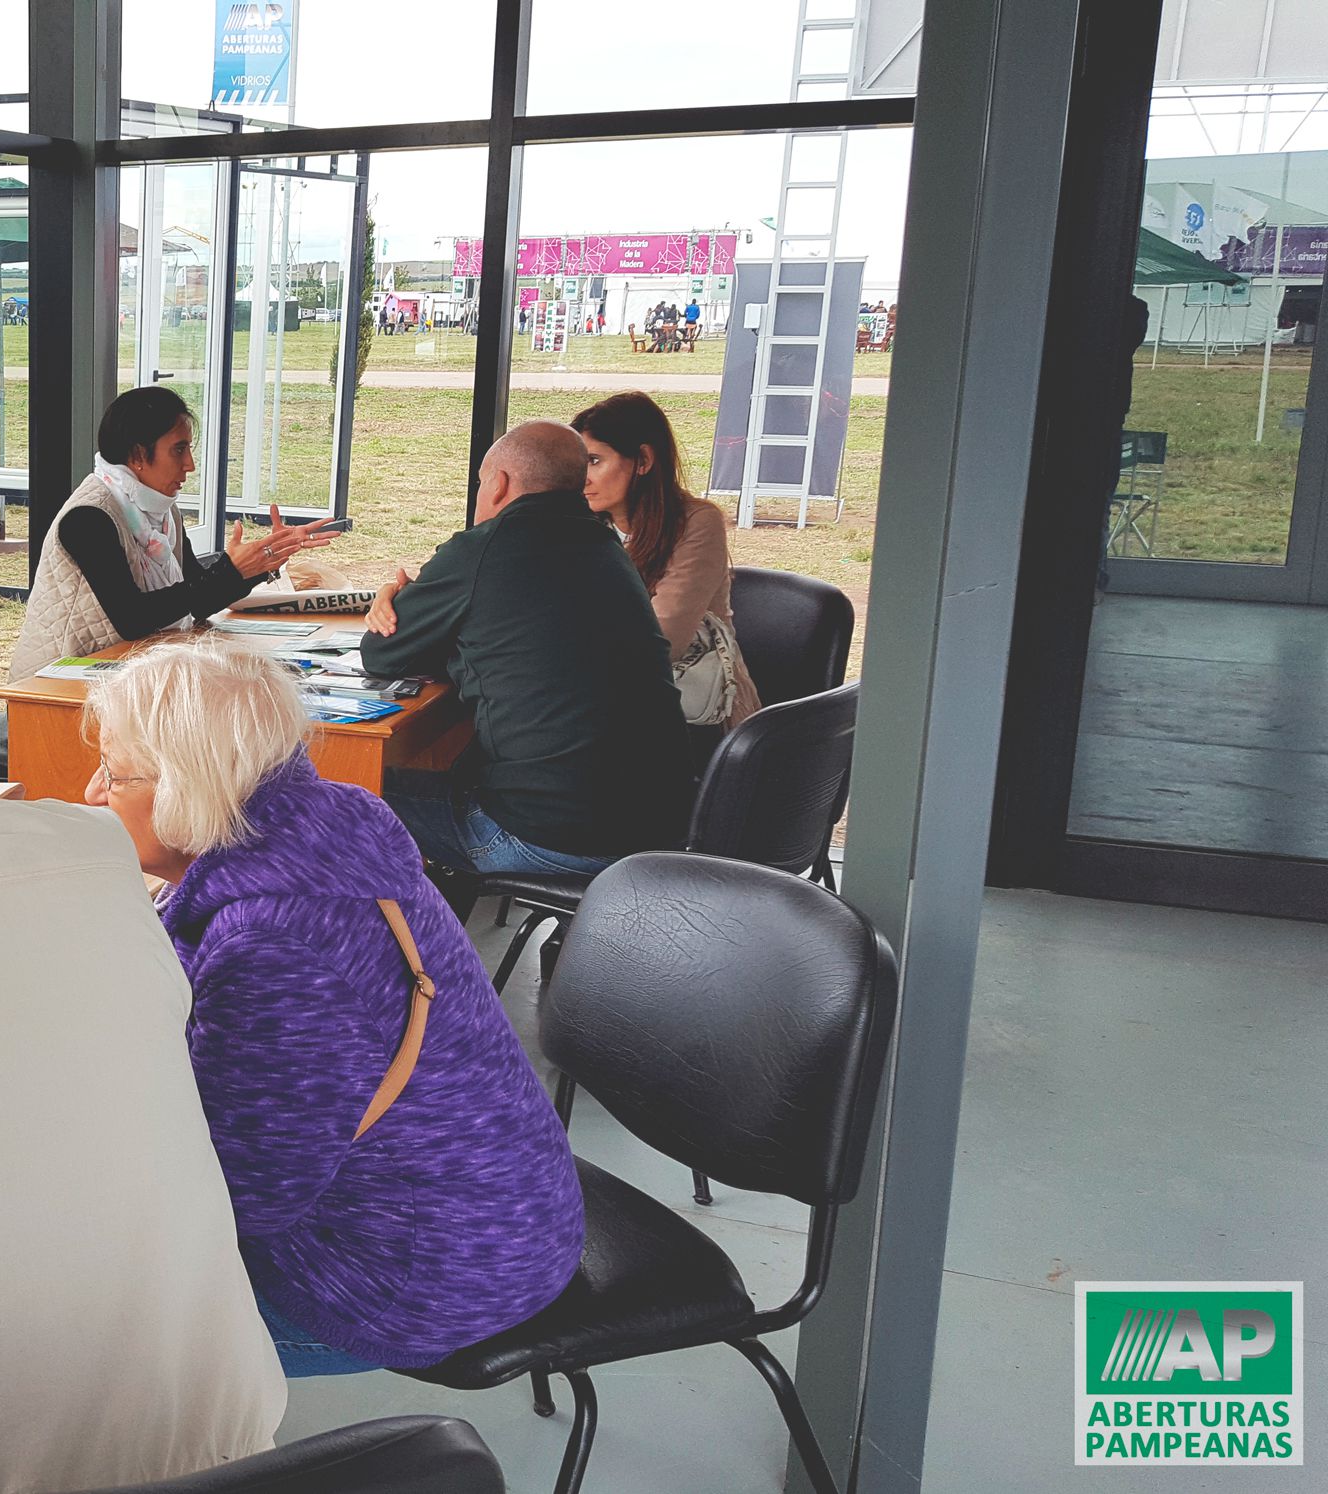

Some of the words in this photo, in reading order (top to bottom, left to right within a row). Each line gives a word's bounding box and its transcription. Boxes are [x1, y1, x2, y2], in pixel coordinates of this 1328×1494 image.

[241, 4, 283, 30] AP
[222, 34, 283, 44] ABERTURAS
[222, 45, 283, 54] PAMPEANAS
[230, 75, 271, 86] VIDRIOS
[619, 239, 649, 248] Industria
[624, 249, 633, 258] de
[634, 249, 641, 258] la
[619, 259, 644, 268] Madera
[303, 592, 377, 610] ABERTU
